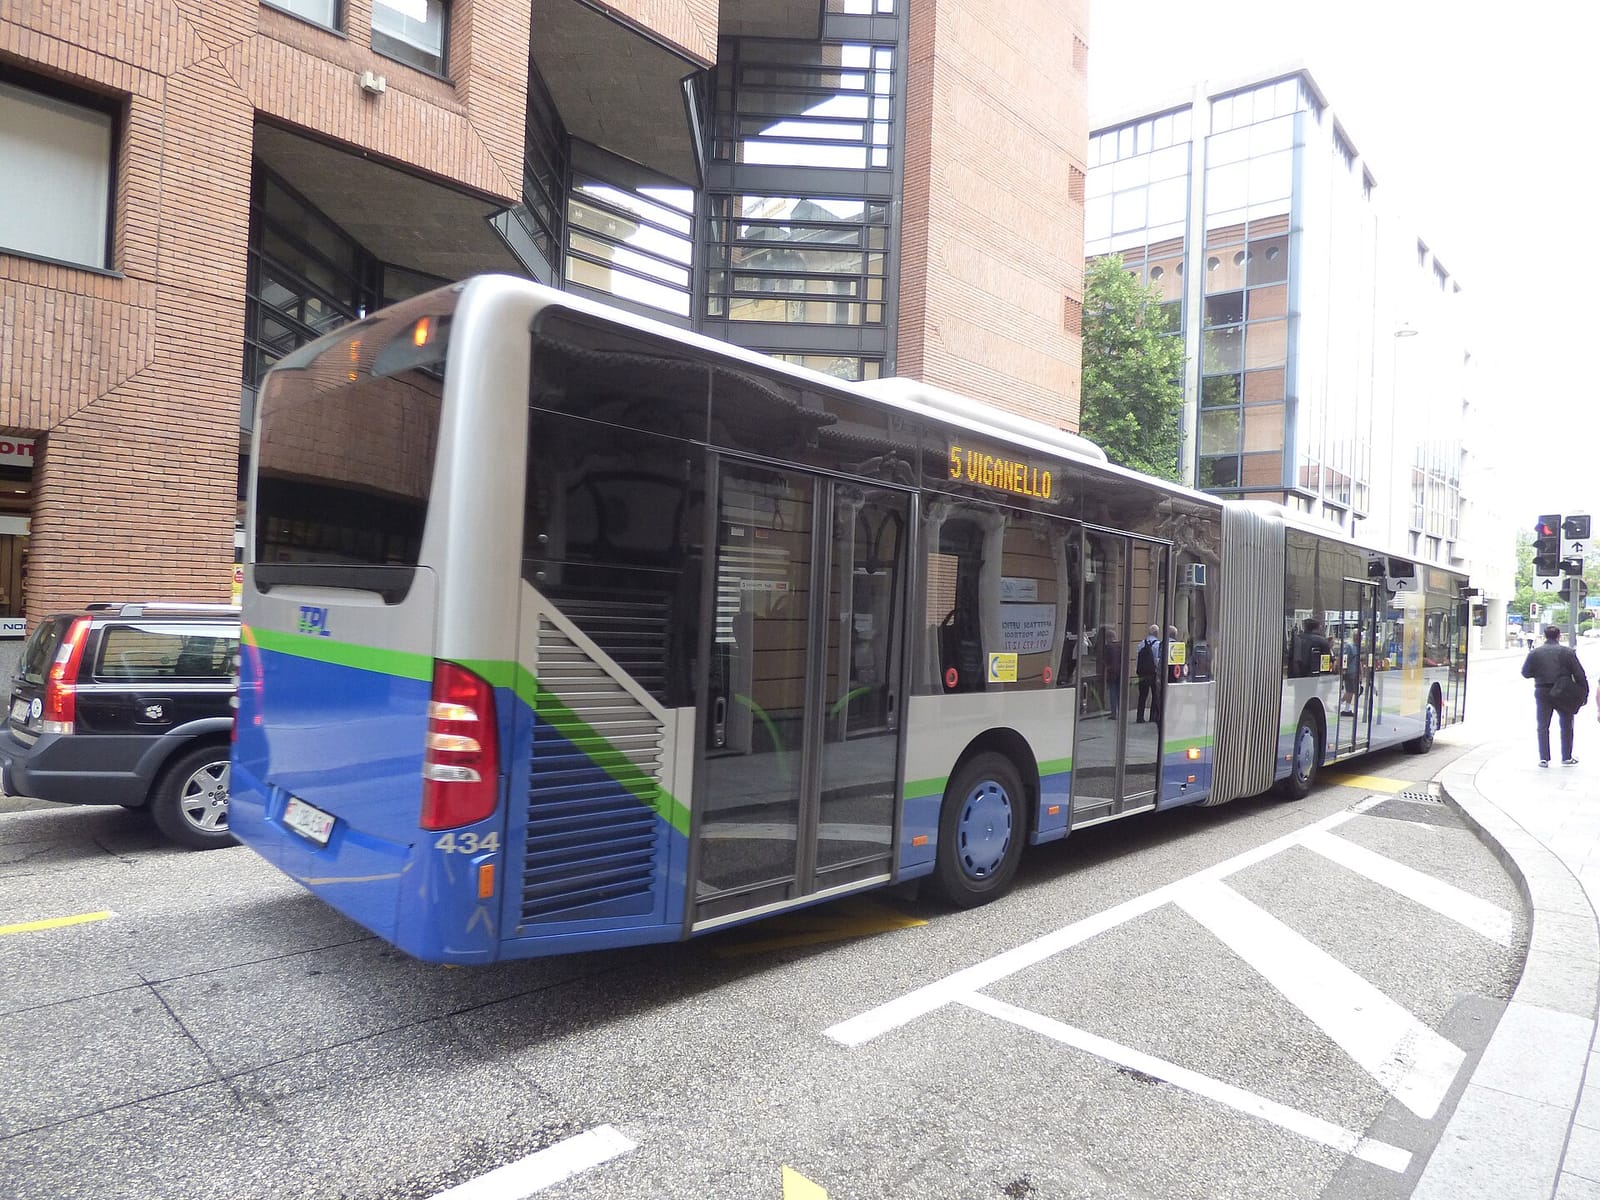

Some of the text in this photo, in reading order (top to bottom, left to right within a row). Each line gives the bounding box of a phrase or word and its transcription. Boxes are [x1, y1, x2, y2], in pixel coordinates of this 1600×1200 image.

[950, 446, 1052, 499] 5 VIGANELLO
[299, 605, 331, 637] TPL
[434, 831, 500, 854] 434
